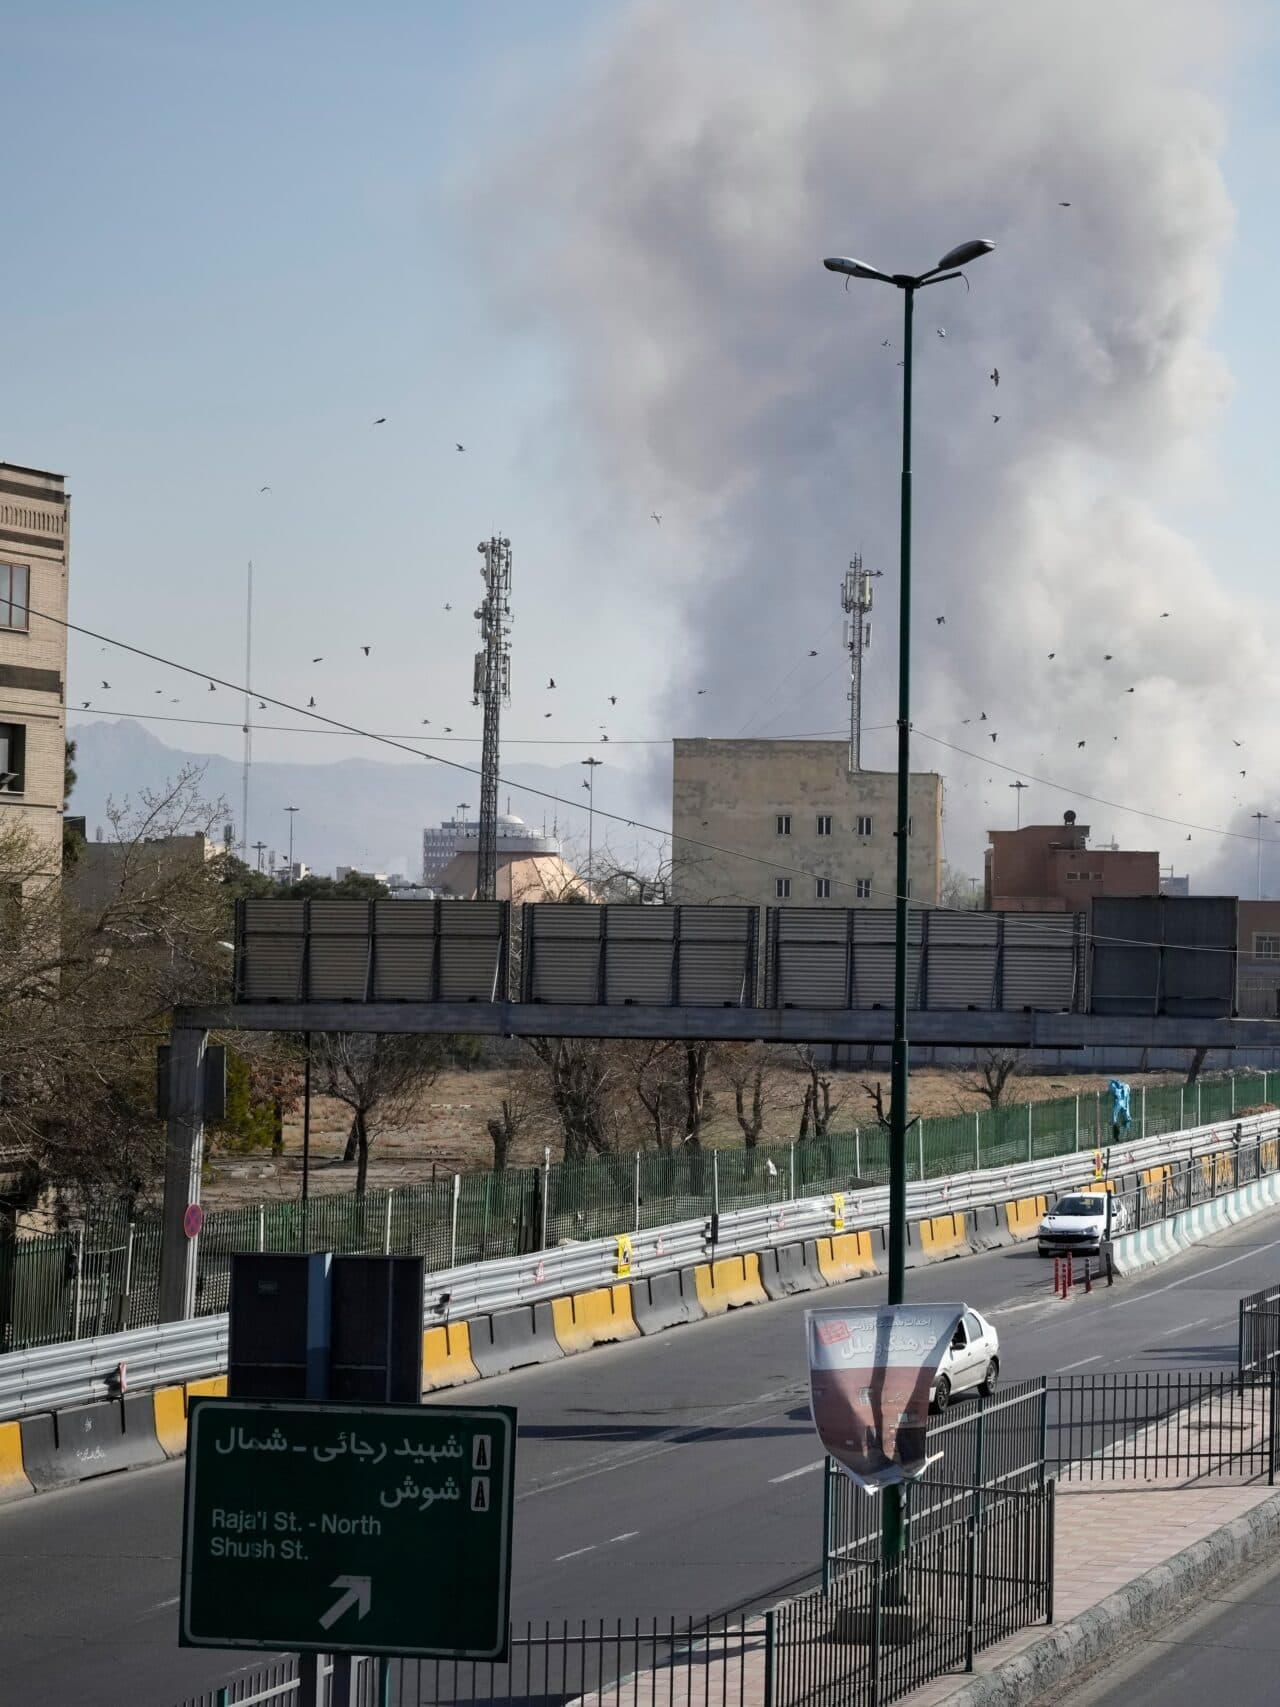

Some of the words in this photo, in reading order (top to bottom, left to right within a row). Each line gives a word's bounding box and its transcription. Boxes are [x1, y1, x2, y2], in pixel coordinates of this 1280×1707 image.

[215, 1426, 288, 1454] شمال
[394, 1434, 464, 1464] شهید
[379, 1475, 461, 1512] شوش
[273, 1511, 303, 1532] St.
[321, 1513, 382, 1536] North
[210, 1536, 276, 1559] Shush
[280, 1539, 309, 1561] St.
